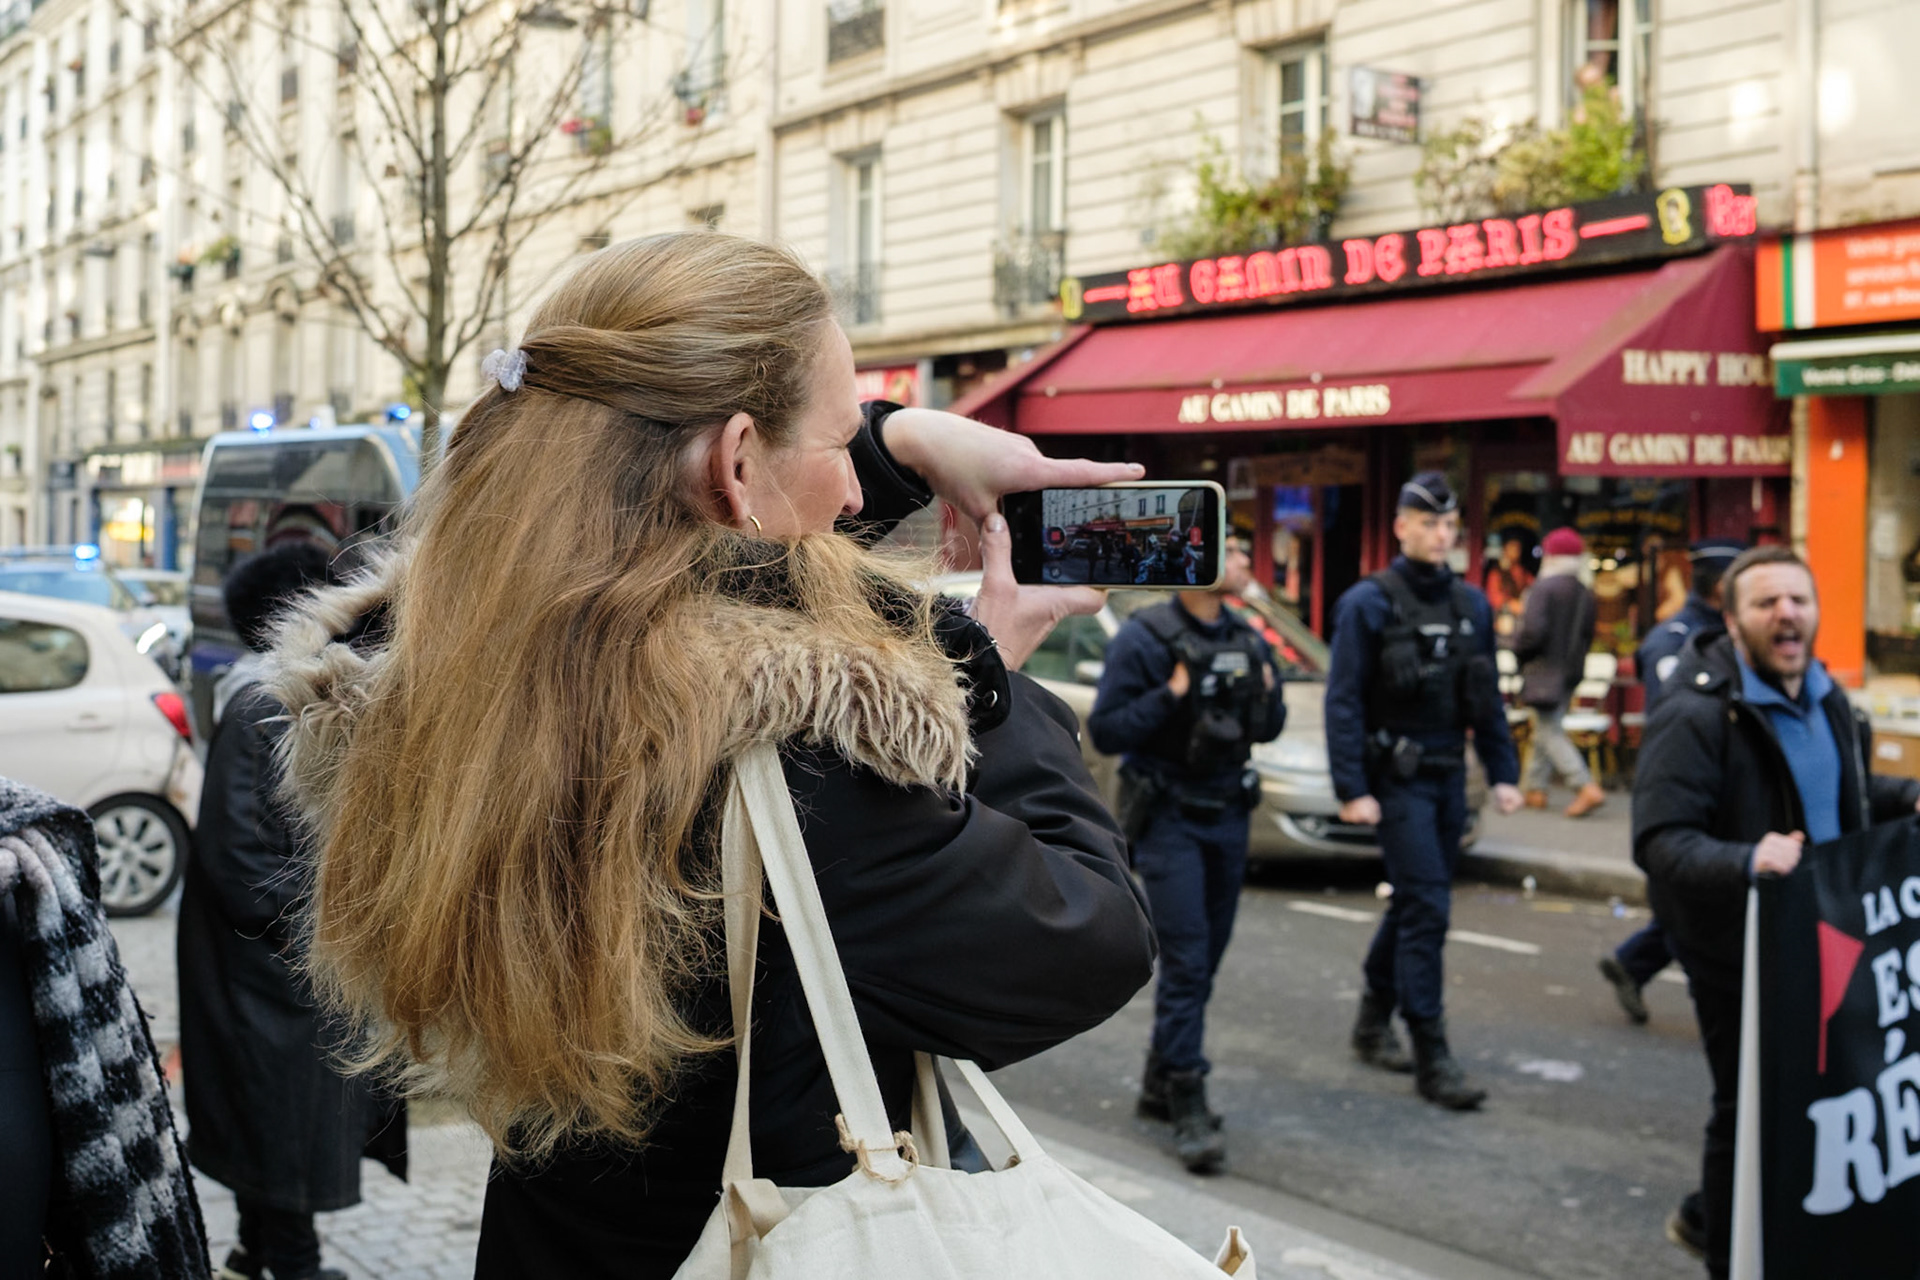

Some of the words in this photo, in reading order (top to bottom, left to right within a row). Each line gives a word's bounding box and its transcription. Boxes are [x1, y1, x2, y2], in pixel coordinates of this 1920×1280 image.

[1343, 232, 1407, 287] DE
[1416, 207, 1577, 277] PARIS
[1622, 350, 1712, 385] HAPPY
[1178, 395, 1210, 423] AU
[1211, 391, 1284, 422] GAMIN
[1286, 389, 1320, 419] DE
[1323, 384, 1391, 417] PARIS
[1566, 433, 1604, 464] AU
[1608, 433, 1690, 465] GAMIN
[1694, 436, 1729, 465] DE
[1862, 885, 1901, 936] LA
